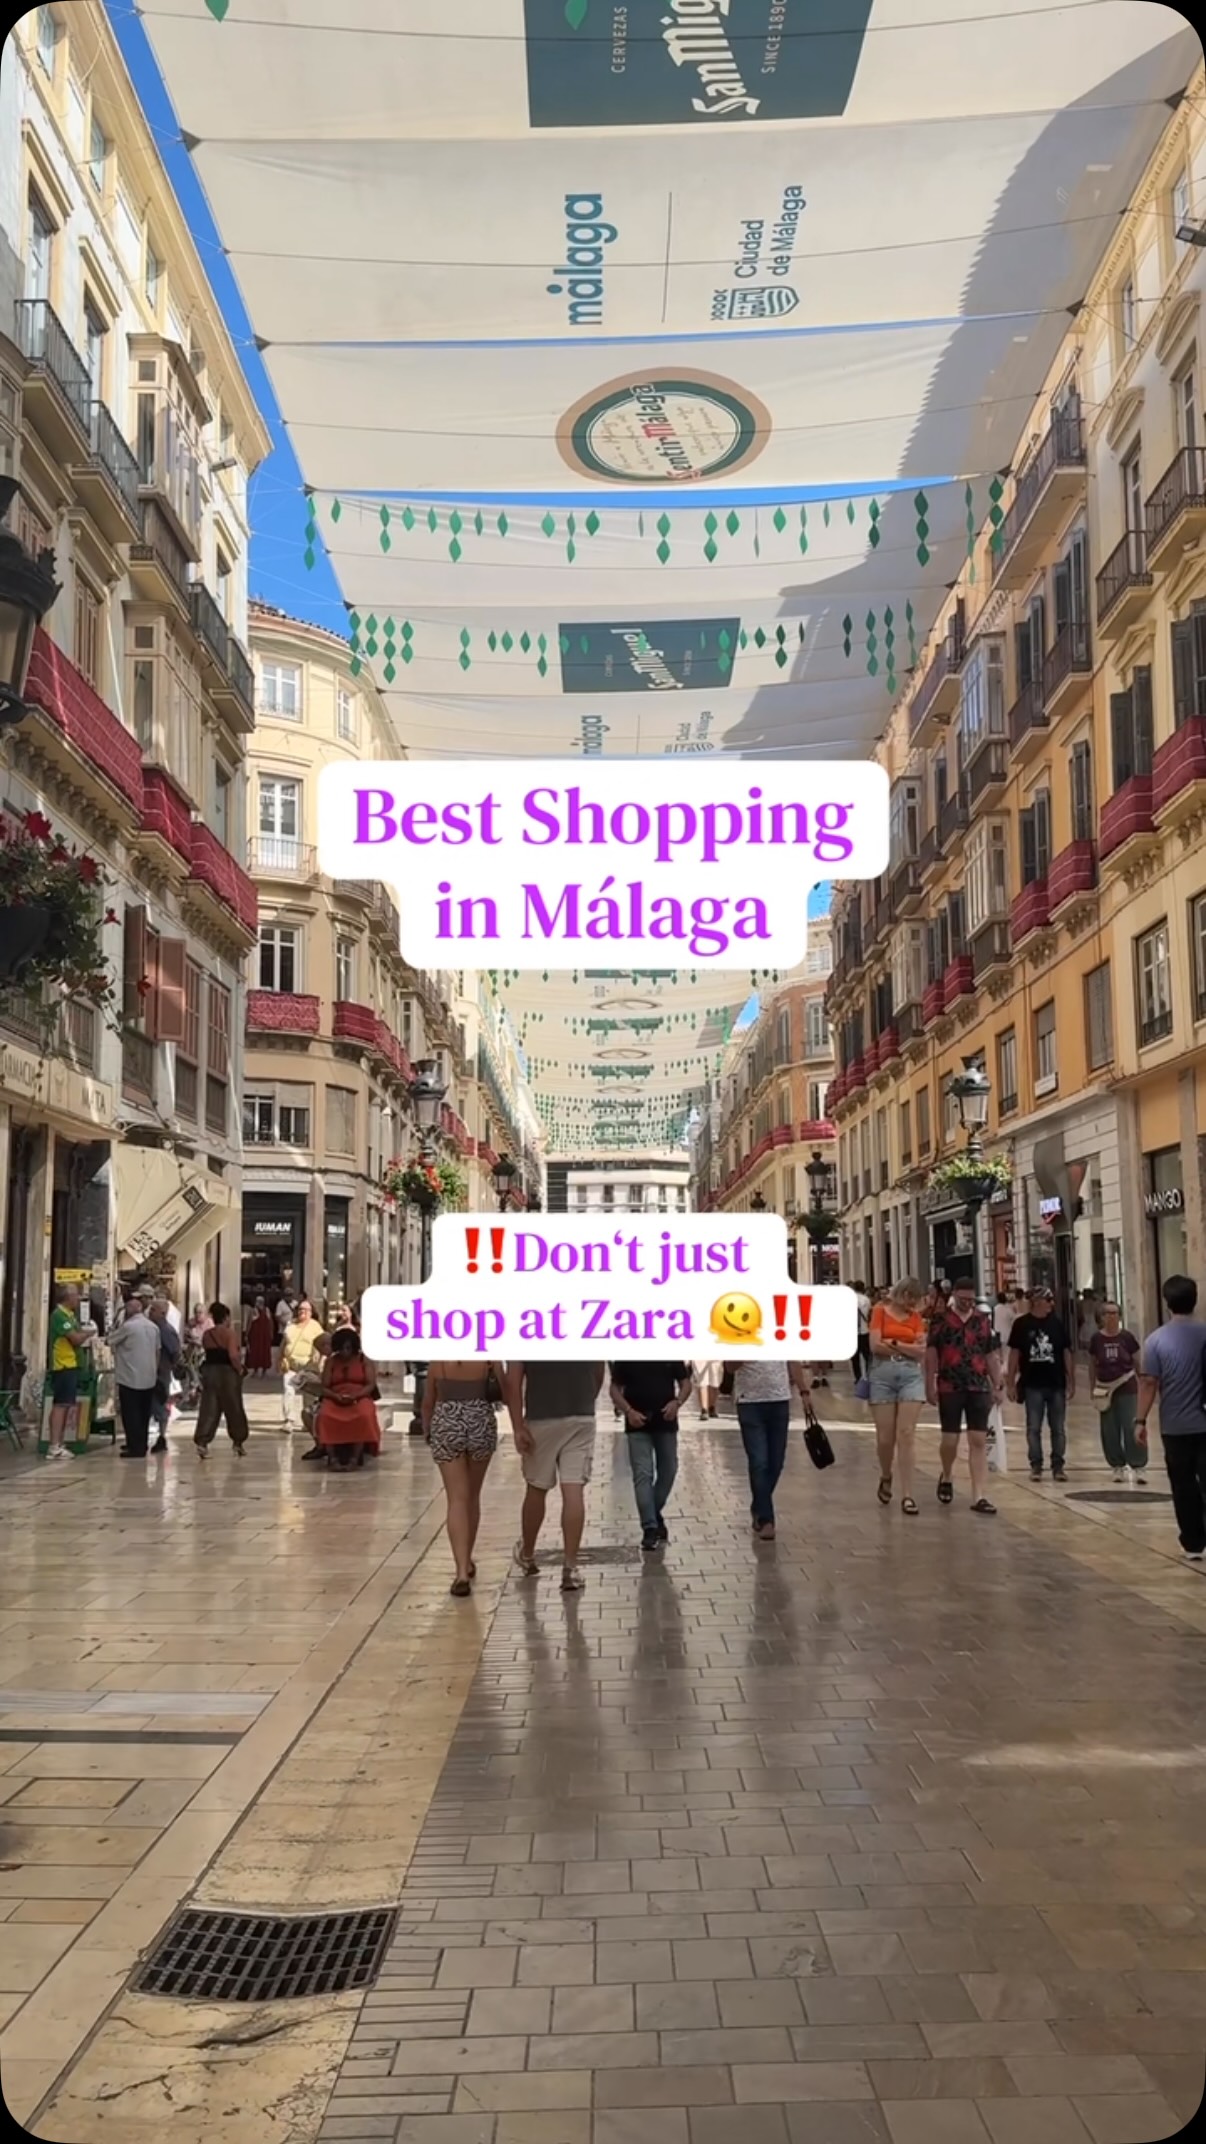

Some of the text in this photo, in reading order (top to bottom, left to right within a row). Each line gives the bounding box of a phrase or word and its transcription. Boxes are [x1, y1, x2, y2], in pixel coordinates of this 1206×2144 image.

[611, 5, 628, 74] CERVEZAS
[761, 35, 781, 74] SINCE
[547, 193, 618, 326] málaga
[735, 219, 764, 279] Ciudad
[766, 185, 806, 276] de Málaga
[1144, 1188, 1182, 1213] MANGO
